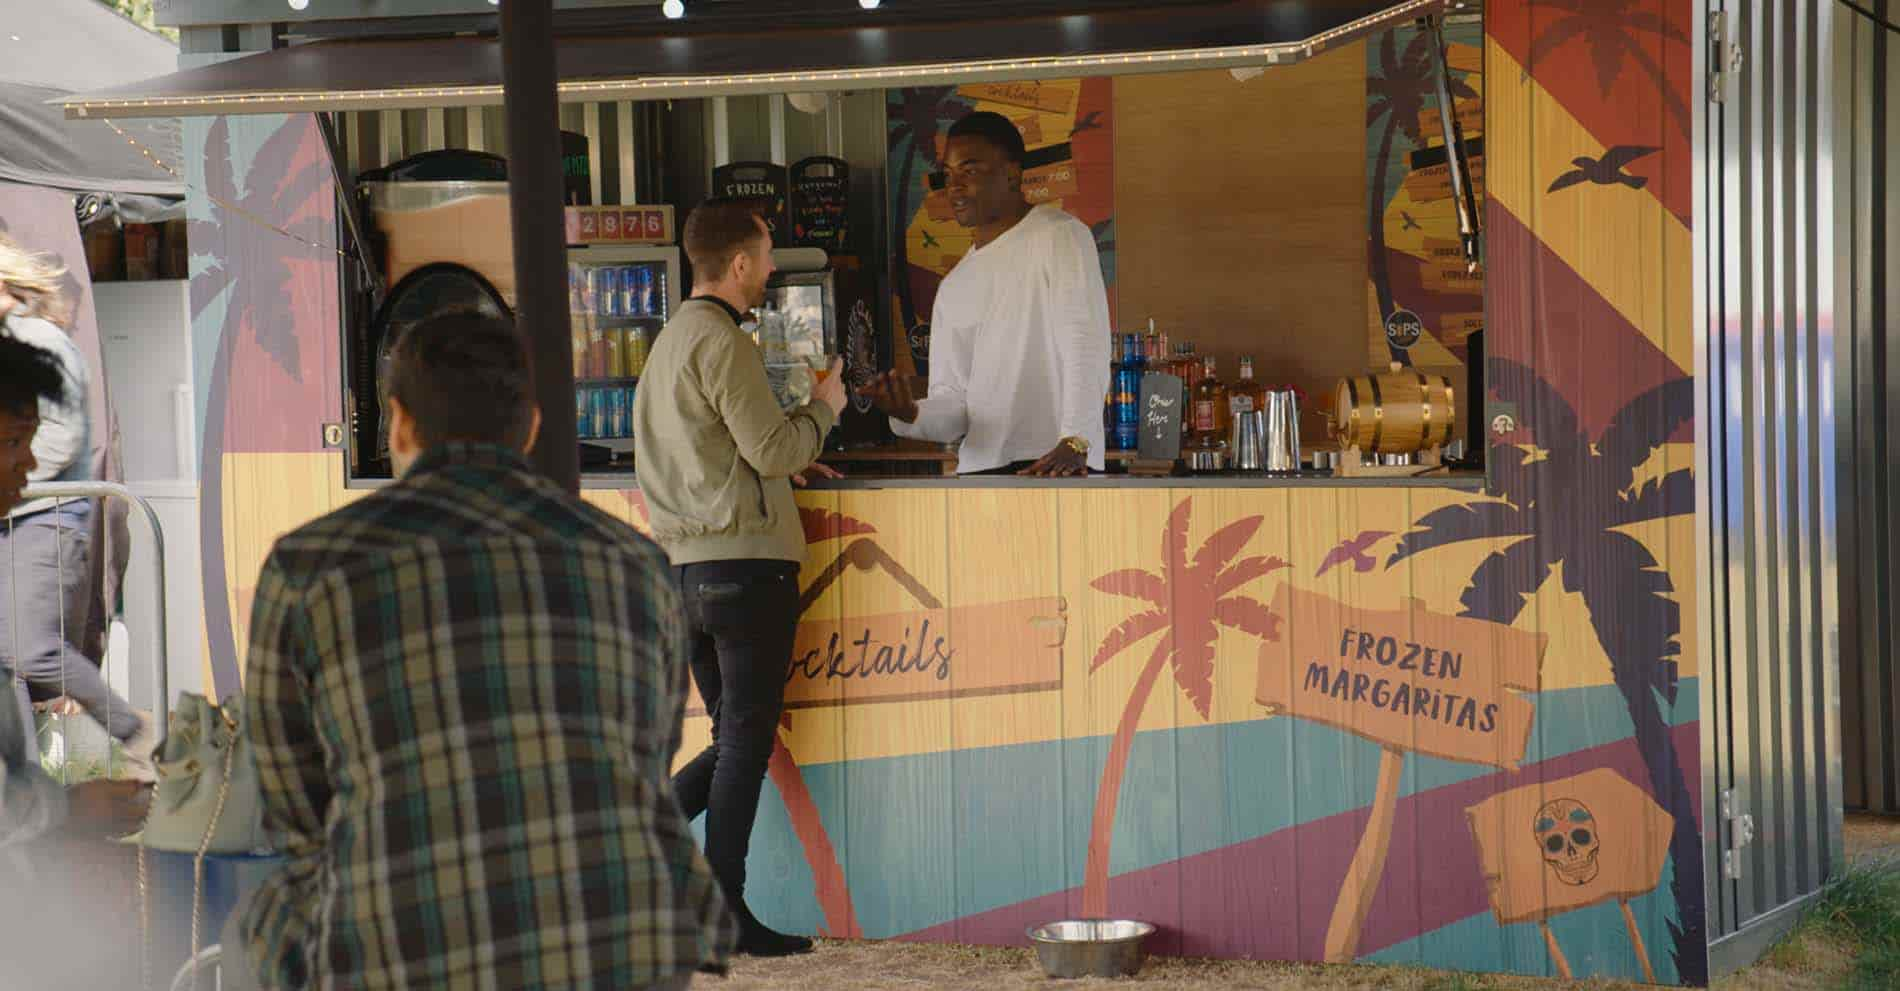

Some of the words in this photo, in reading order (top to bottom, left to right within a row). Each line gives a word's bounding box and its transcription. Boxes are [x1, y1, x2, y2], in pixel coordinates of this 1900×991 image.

[726, 183, 776, 197] FROZEN
[785, 618, 957, 683] ocktails
[1340, 627, 1463, 680] FROZEN
